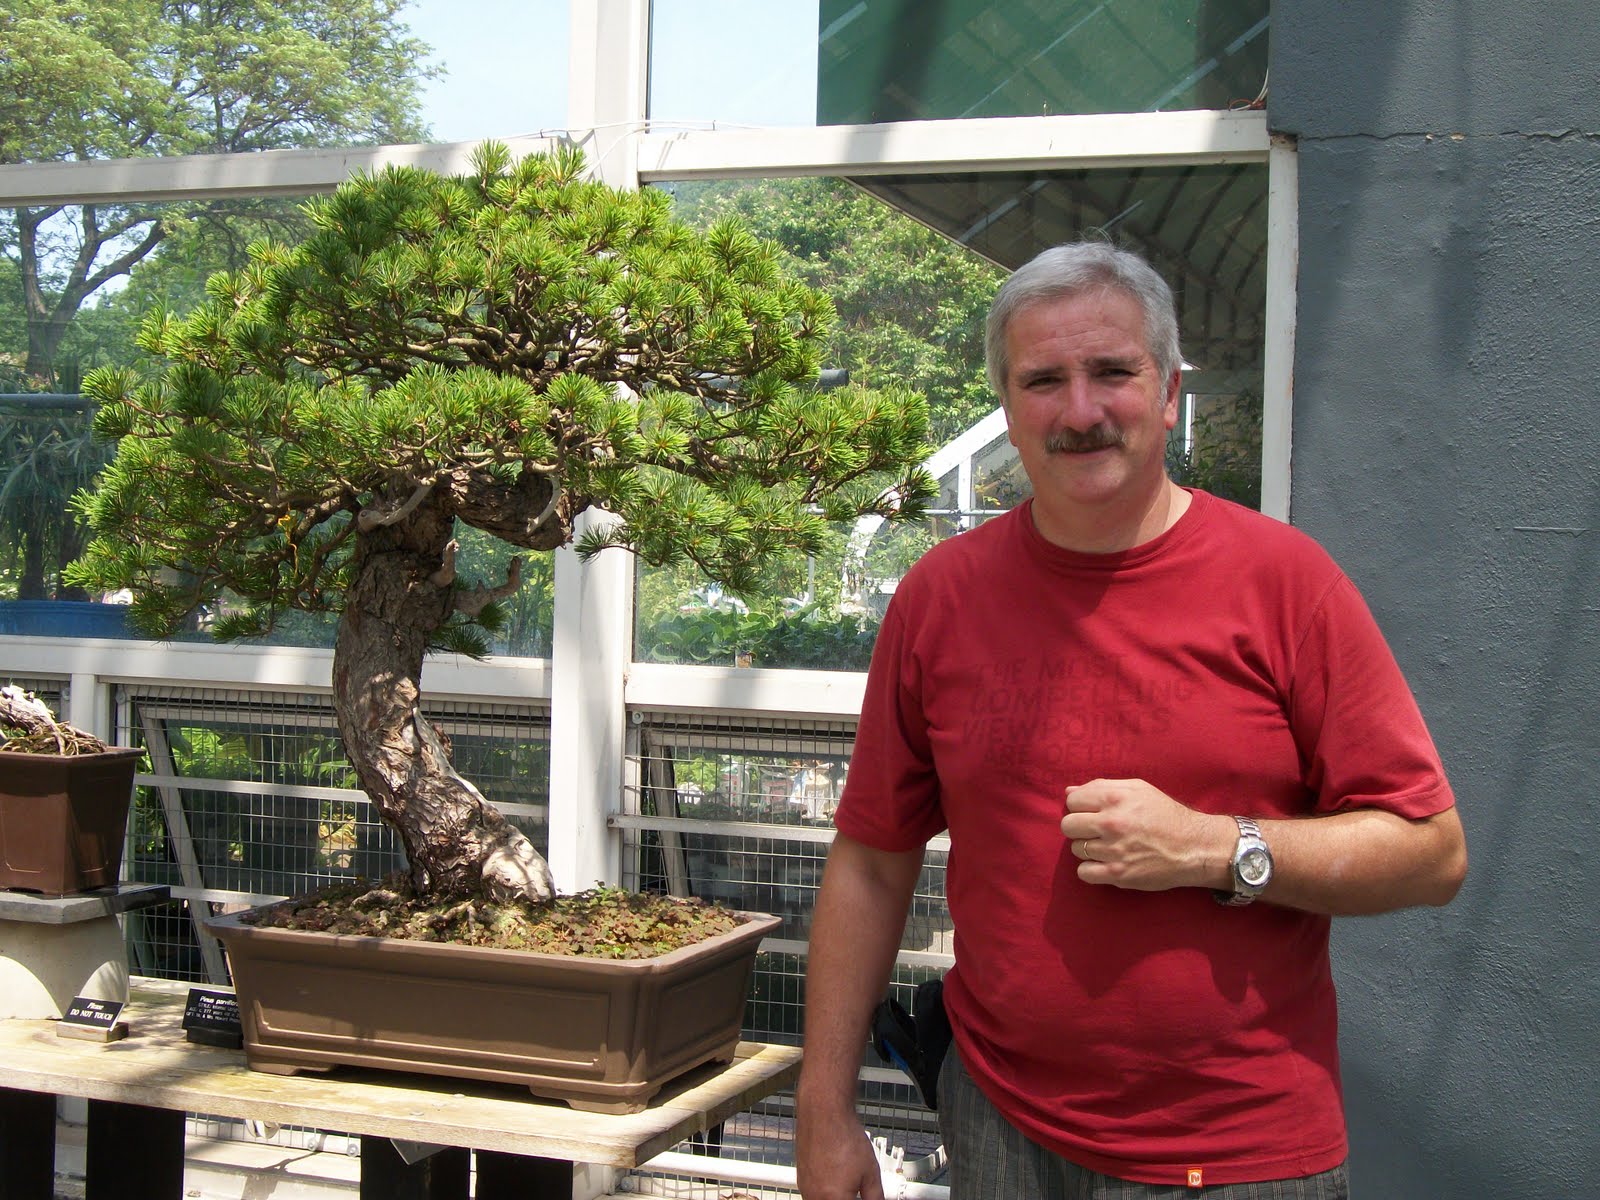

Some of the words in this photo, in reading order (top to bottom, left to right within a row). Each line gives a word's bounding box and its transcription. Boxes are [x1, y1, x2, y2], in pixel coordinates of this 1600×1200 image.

[1040, 653, 1124, 682] MOST
[970, 679, 1193, 716] COMPELLING
[985, 742, 1033, 767] ARE
[1046, 740, 1138, 766] OFTEN
[70, 1008, 80, 1016] DO
[80, 1010, 94, 1018] NOT
[94, 1012, 114, 1020] TOUCH
[87, 1002, 105, 1010] Please
